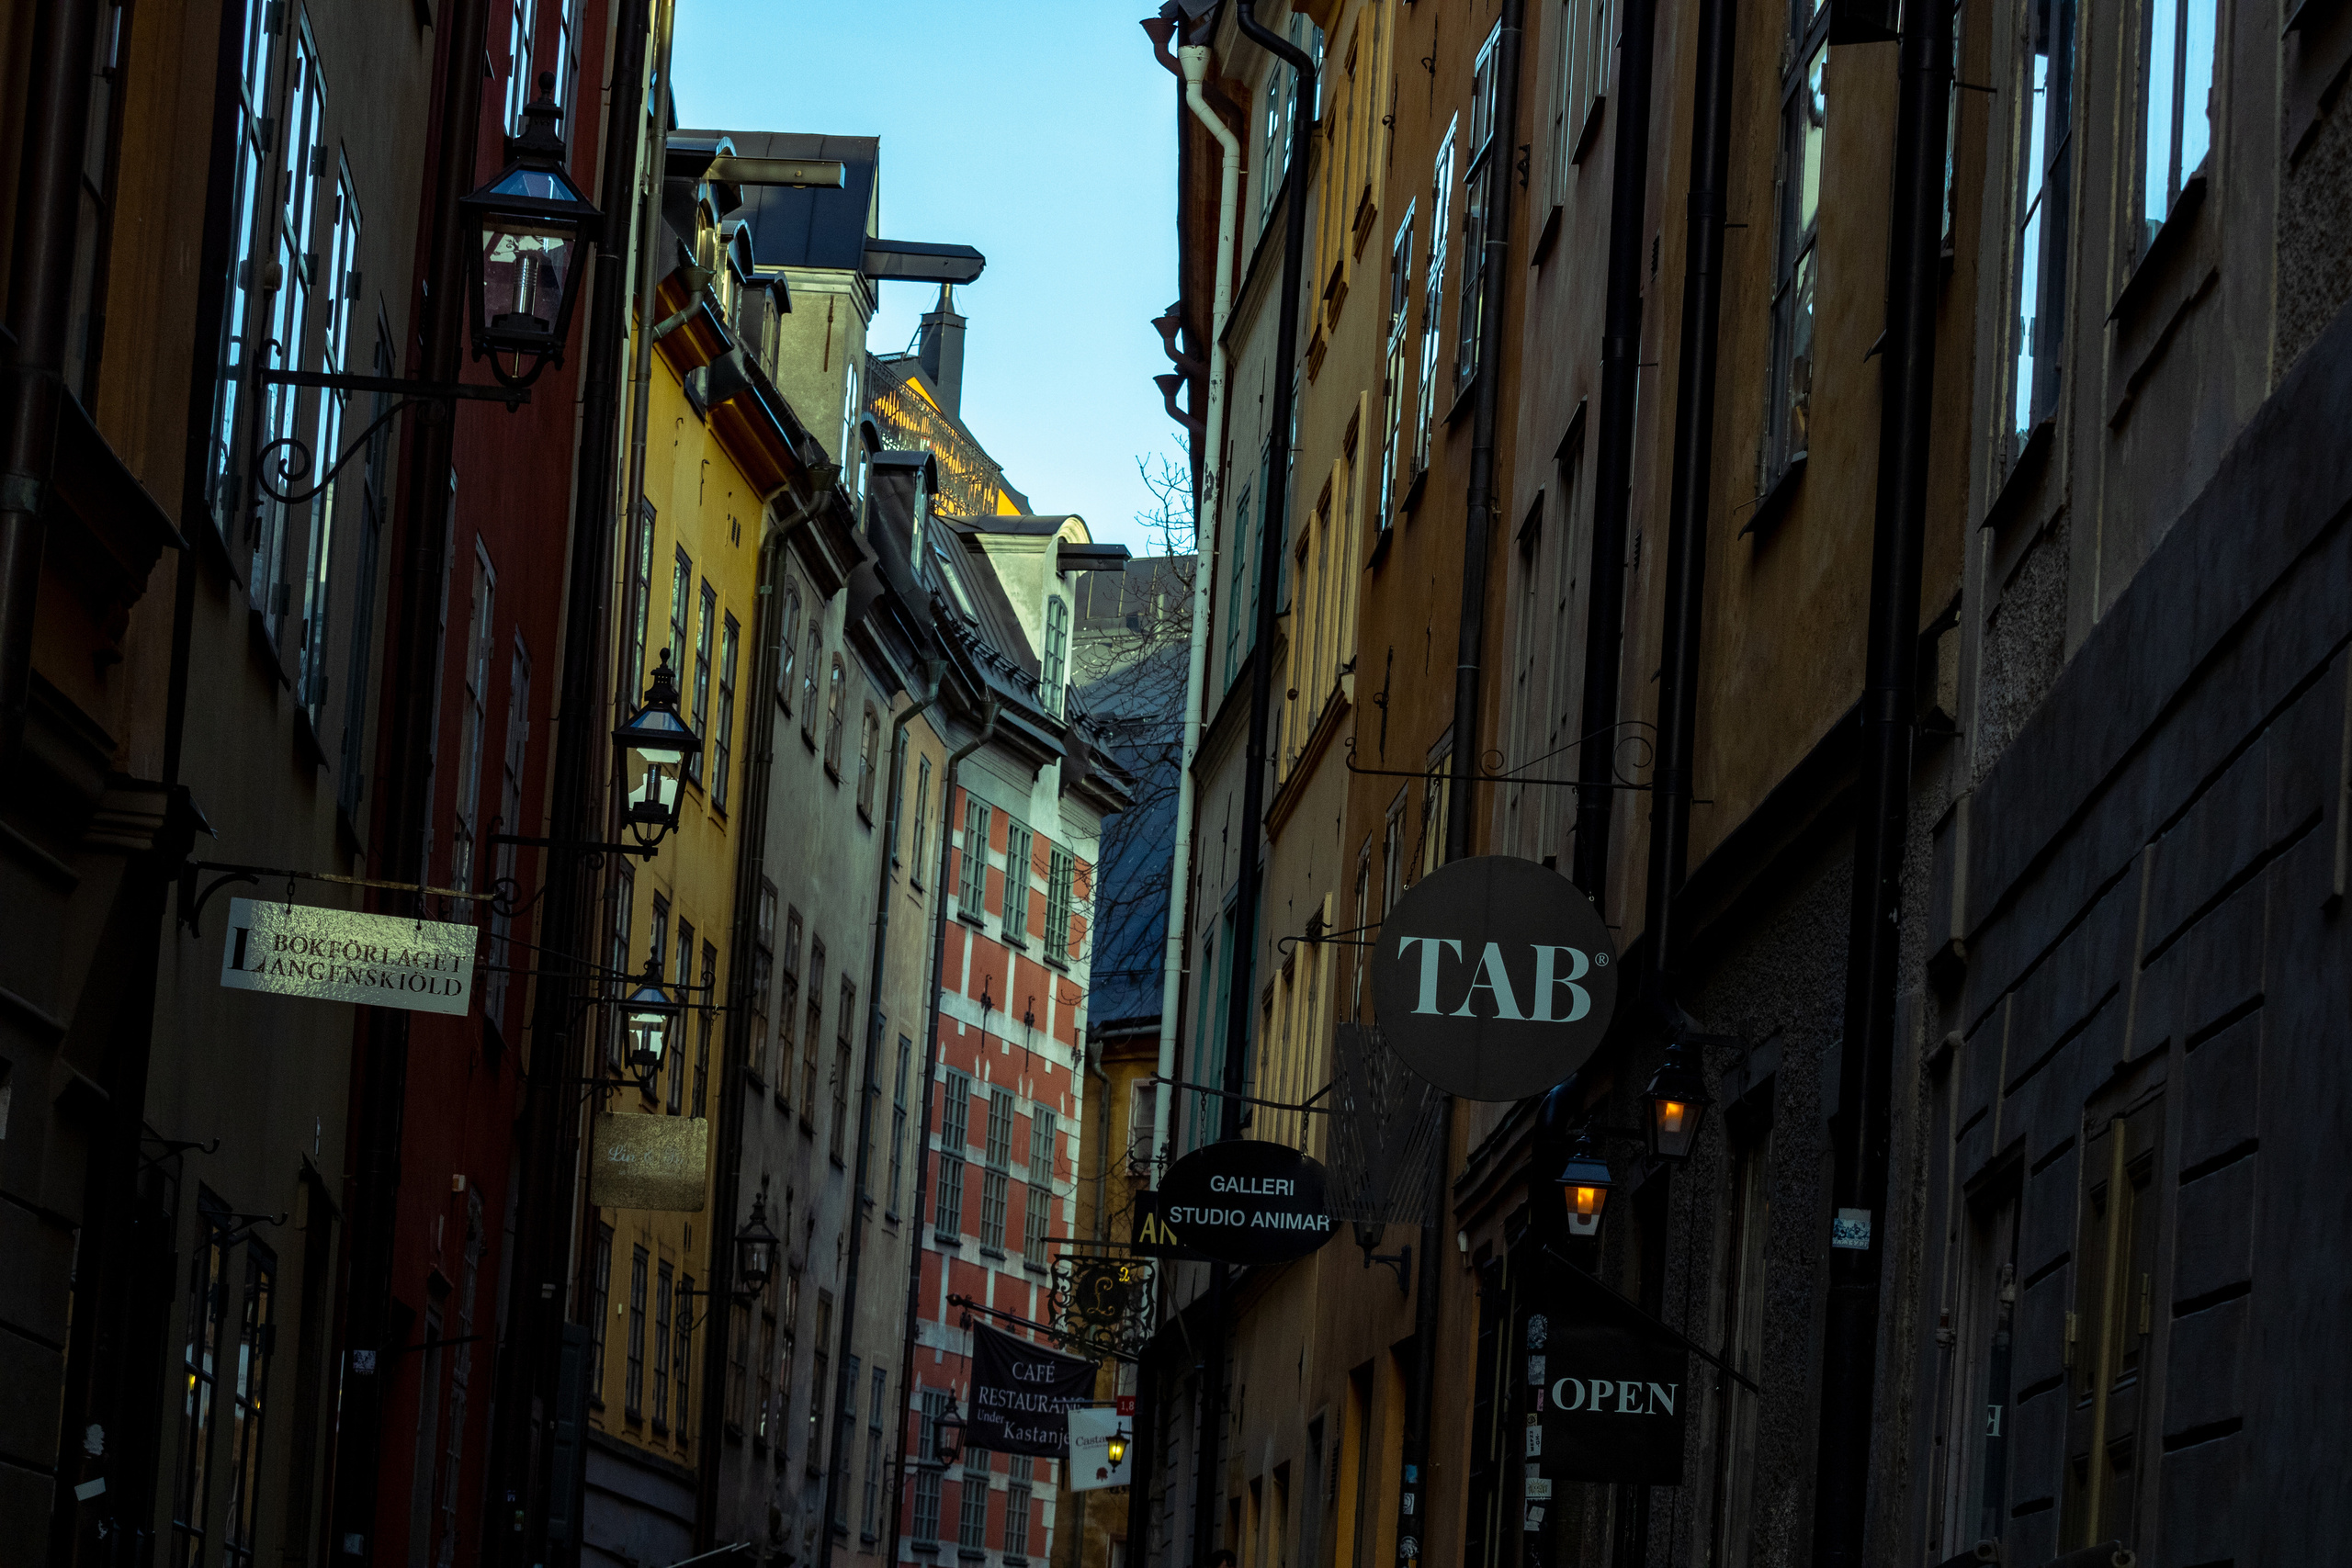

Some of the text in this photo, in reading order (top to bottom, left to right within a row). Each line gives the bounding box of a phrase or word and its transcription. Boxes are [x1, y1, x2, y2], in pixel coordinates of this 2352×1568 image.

[228, 926, 463, 997] LANGENSKIÖLD
[274, 933, 466, 974] BOKFÖRLAGET
[1210, 1174, 1295, 1197] GALLERI
[1169, 1205, 1246, 1227] STUDIO
[1012, 1360, 1056, 1383] CAFÉ
[1551, 1377, 1679, 1416] OPEN
[977, 1408, 1005, 1425] Under
[1075, 1435, 1108, 1447] Casta
